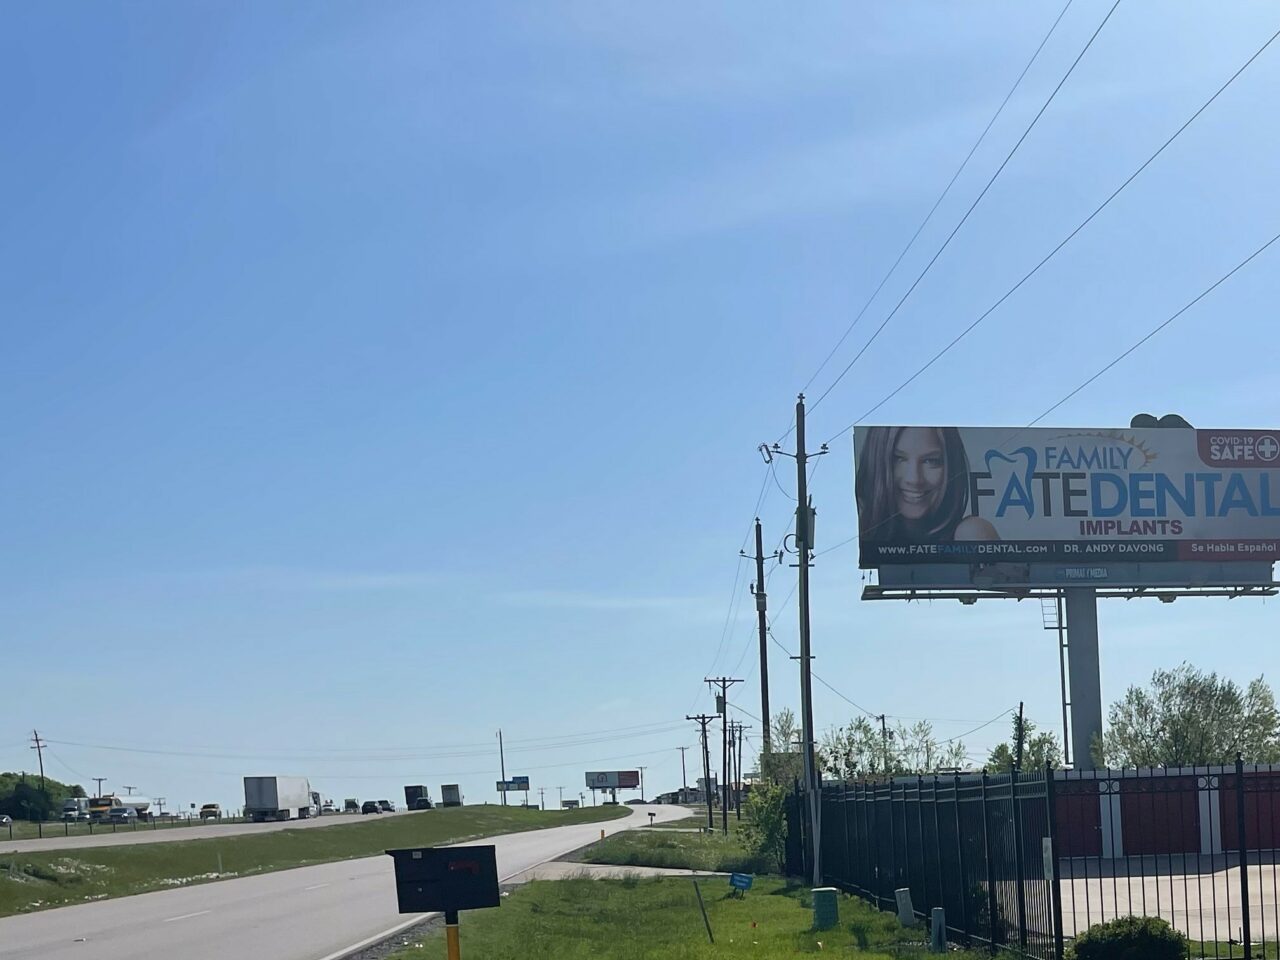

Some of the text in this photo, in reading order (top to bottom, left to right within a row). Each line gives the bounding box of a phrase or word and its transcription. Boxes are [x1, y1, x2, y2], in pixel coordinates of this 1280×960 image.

[1210, 437, 1254, 446] COVID-19
[1044, 445, 1133, 470] FAMILY
[1210, 445, 1255, 461] SAFE
[1080, 520, 1183, 536] IMPLANTS
[1064, 544, 1083, 553] DR.
[1085, 544, 1117, 553] ANDY
[1118, 543, 1164, 553] DAVONG
[1191, 543, 1277, 553] Se Habla Español
